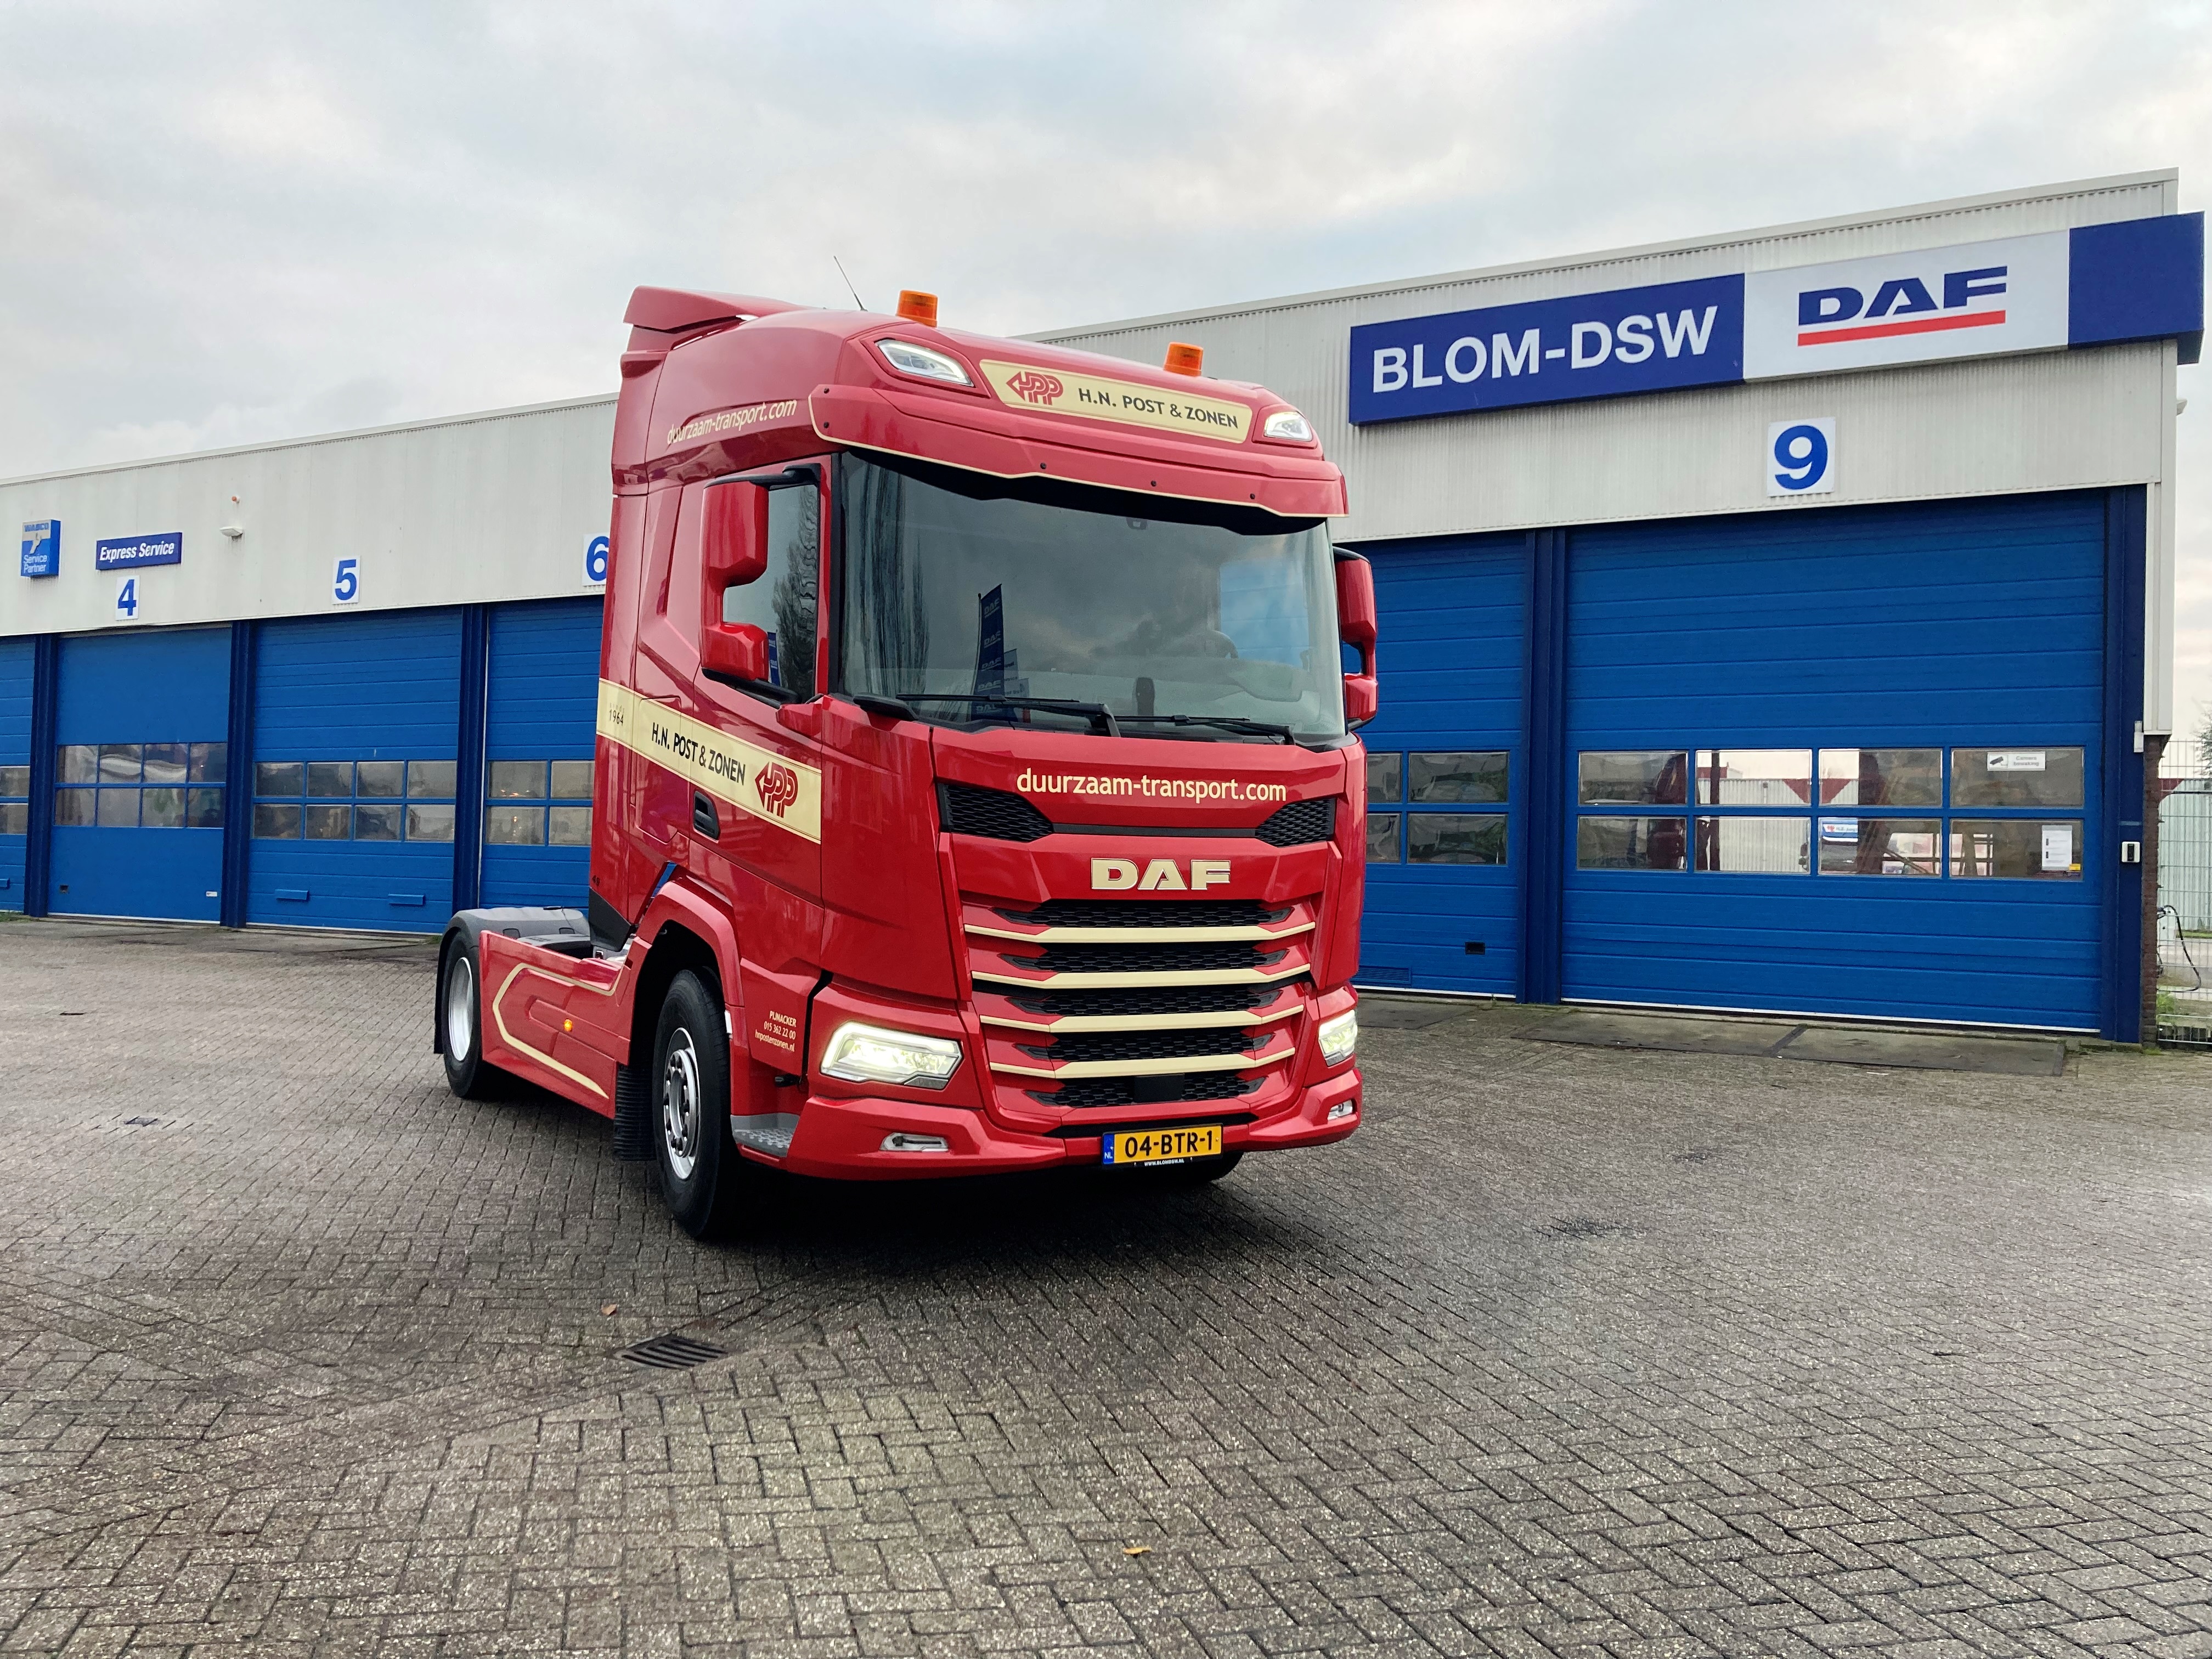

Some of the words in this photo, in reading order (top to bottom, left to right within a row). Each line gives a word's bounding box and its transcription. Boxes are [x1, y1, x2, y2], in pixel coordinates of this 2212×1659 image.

[1798, 266, 2008, 326] DAF
[1373, 305, 1718, 393] BLOM-DSW
[667, 399, 798, 445] duurzaam-transport.com
[1079, 388, 1116, 407] H.N.
[1122, 394, 1165, 415] POST
[1170, 403, 1182, 419] &
[1184, 407, 1238, 429] ZONEN
[1774, 425, 1829, 490] 9
[23, 554, 48, 564] Service
[24, 564, 47, 574] Partner
[99, 546, 137, 563] Express
[138, 540, 175, 557] Service
[586, 536, 610, 582] 6
[117, 579, 137, 617] 4
[335, 559, 357, 601] 5
[609, 709, 624, 726] 1964
[652, 722, 670, 750] H.N.
[673, 732, 698, 762] POST
[699, 745, 707, 768] &
[708, 749, 746, 786] ZONEN
[1017, 768, 1287, 804] duurzaam-transport.com
[1091, 857, 1231, 890] DAF
[764, 1020, 772, 1031] 015
[772, 1024, 781, 1035] 362
[782, 1027, 788, 1037] 22
[789, 1030, 796, 1040] 00
[769, 1010, 797, 1028] PIJNACKER
[755, 1029, 795, 1052] hnpostenzonen.nl
[1125, 1130, 1212, 1158] 04-BTR-1
